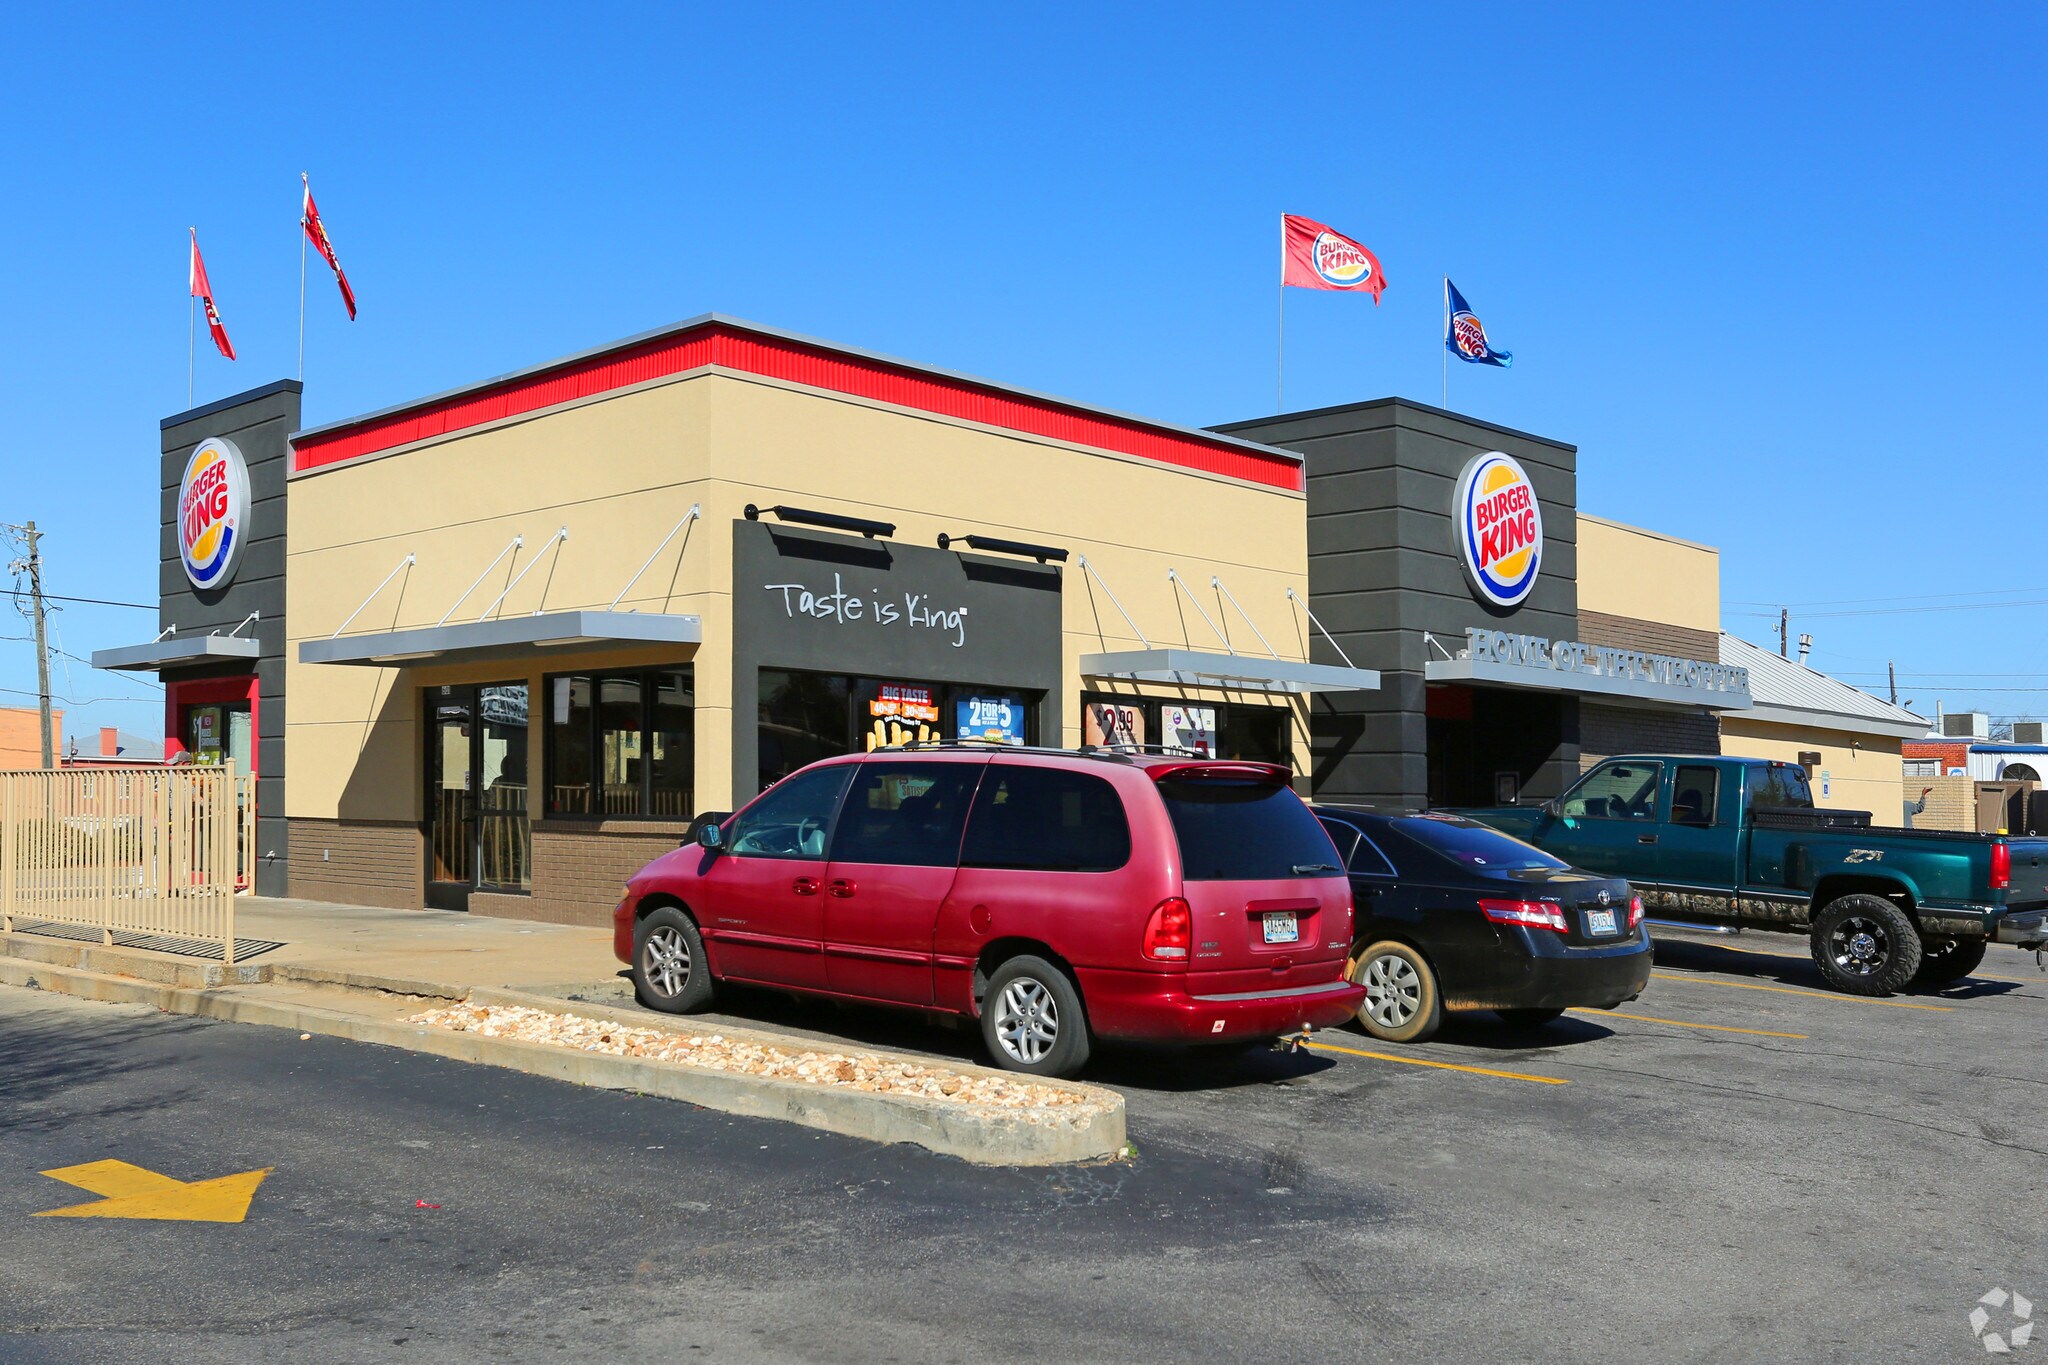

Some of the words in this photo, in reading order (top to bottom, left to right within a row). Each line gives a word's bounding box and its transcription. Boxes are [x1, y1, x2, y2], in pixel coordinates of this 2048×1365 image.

[1321, 251, 1366, 273] KING
[1455, 331, 1485, 357] KNG
[182, 459, 226, 520] BURGER
[1476, 484, 1531, 531] BURGER
[183, 482, 229, 558] KING
[1479, 508, 1536, 569] KING
[764, 572, 863, 624] Taste
[872, 588, 900, 626] is
[905, 592, 965, 648] King
[1465, 626, 1551, 668] HOME
[1552, 639, 1594, 675] OF
[1594, 645, 1648, 681] THE
[1648, 653, 1750, 695] WHOPPER
[882, 686, 899, 700] BIG
[900, 688, 928, 704] TASTE
[969, 696, 981, 727] 2
[981, 702, 998, 717] FOR
[998, 698, 1012, 728] $5
[1096, 708, 1133, 746] $2.99
